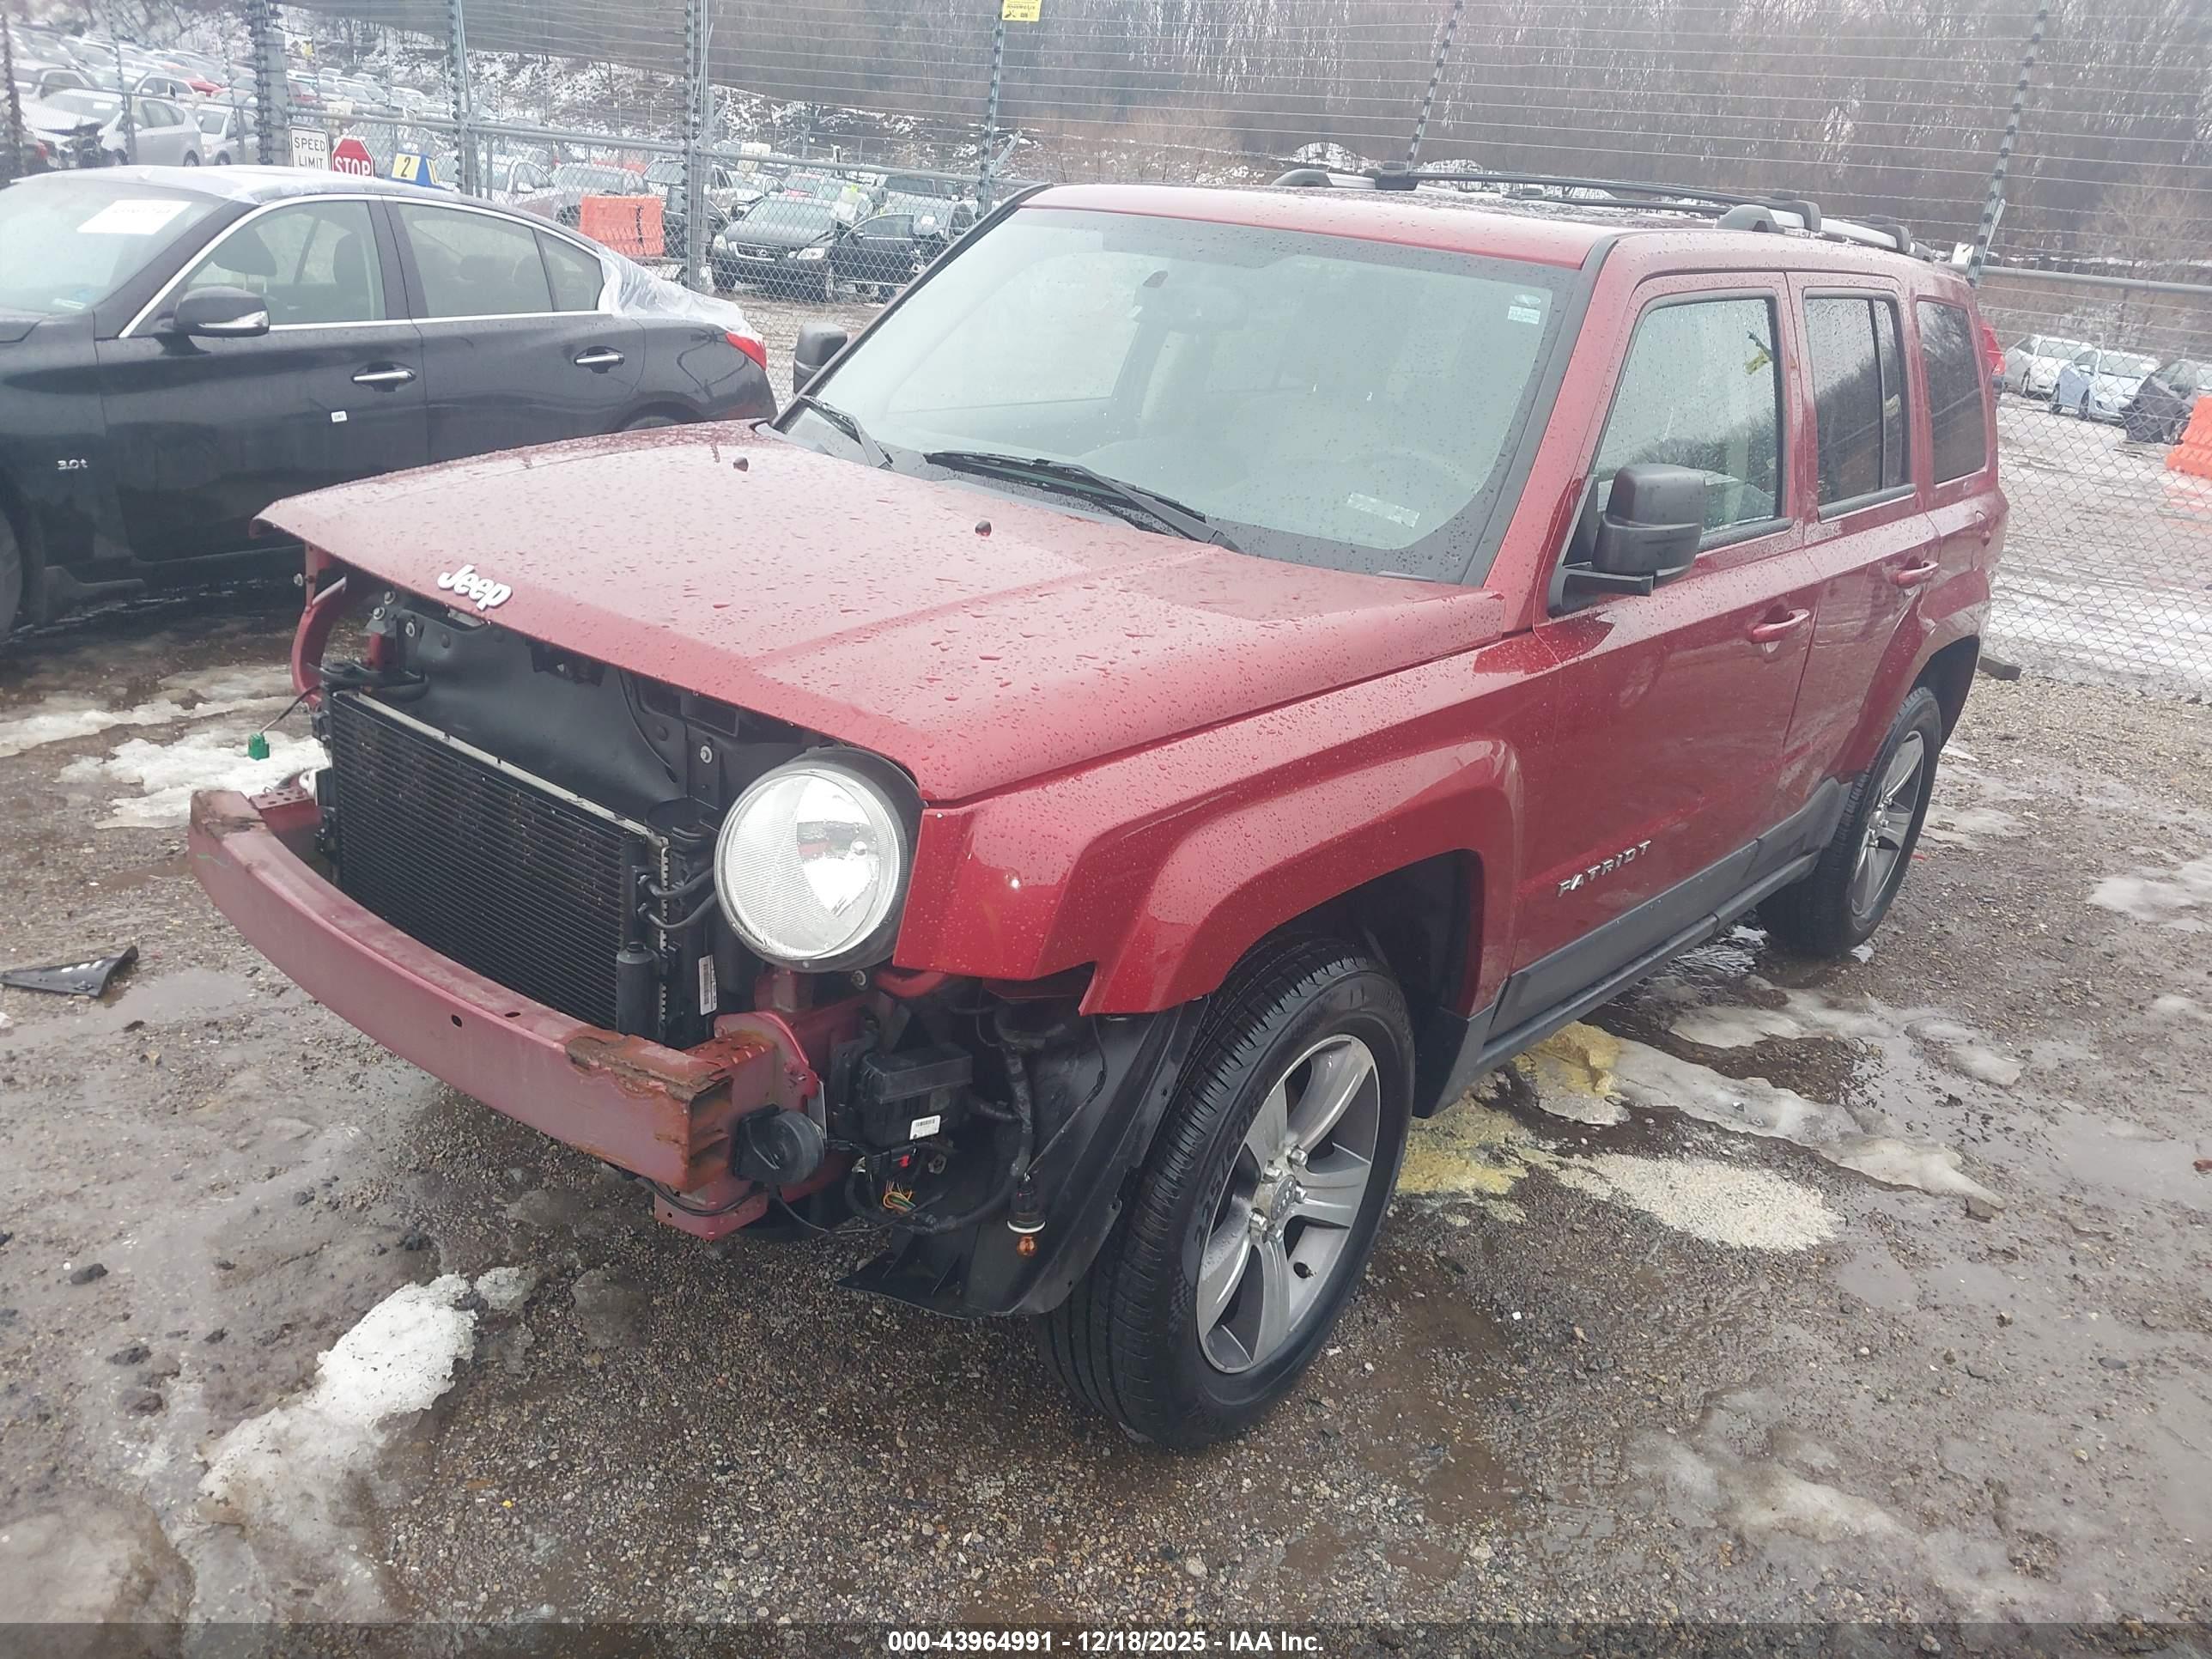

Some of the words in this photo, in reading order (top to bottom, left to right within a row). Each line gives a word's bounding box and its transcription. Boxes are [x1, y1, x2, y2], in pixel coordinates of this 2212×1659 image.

[294, 137, 326, 152] SPEED
[299, 157, 324, 169] LIMIT
[334, 156, 371, 178] STOP
[400, 156, 411, 178] 2
[437, 563, 513, 611] Jeep
[1557, 840, 1651, 897] PATRIOT
